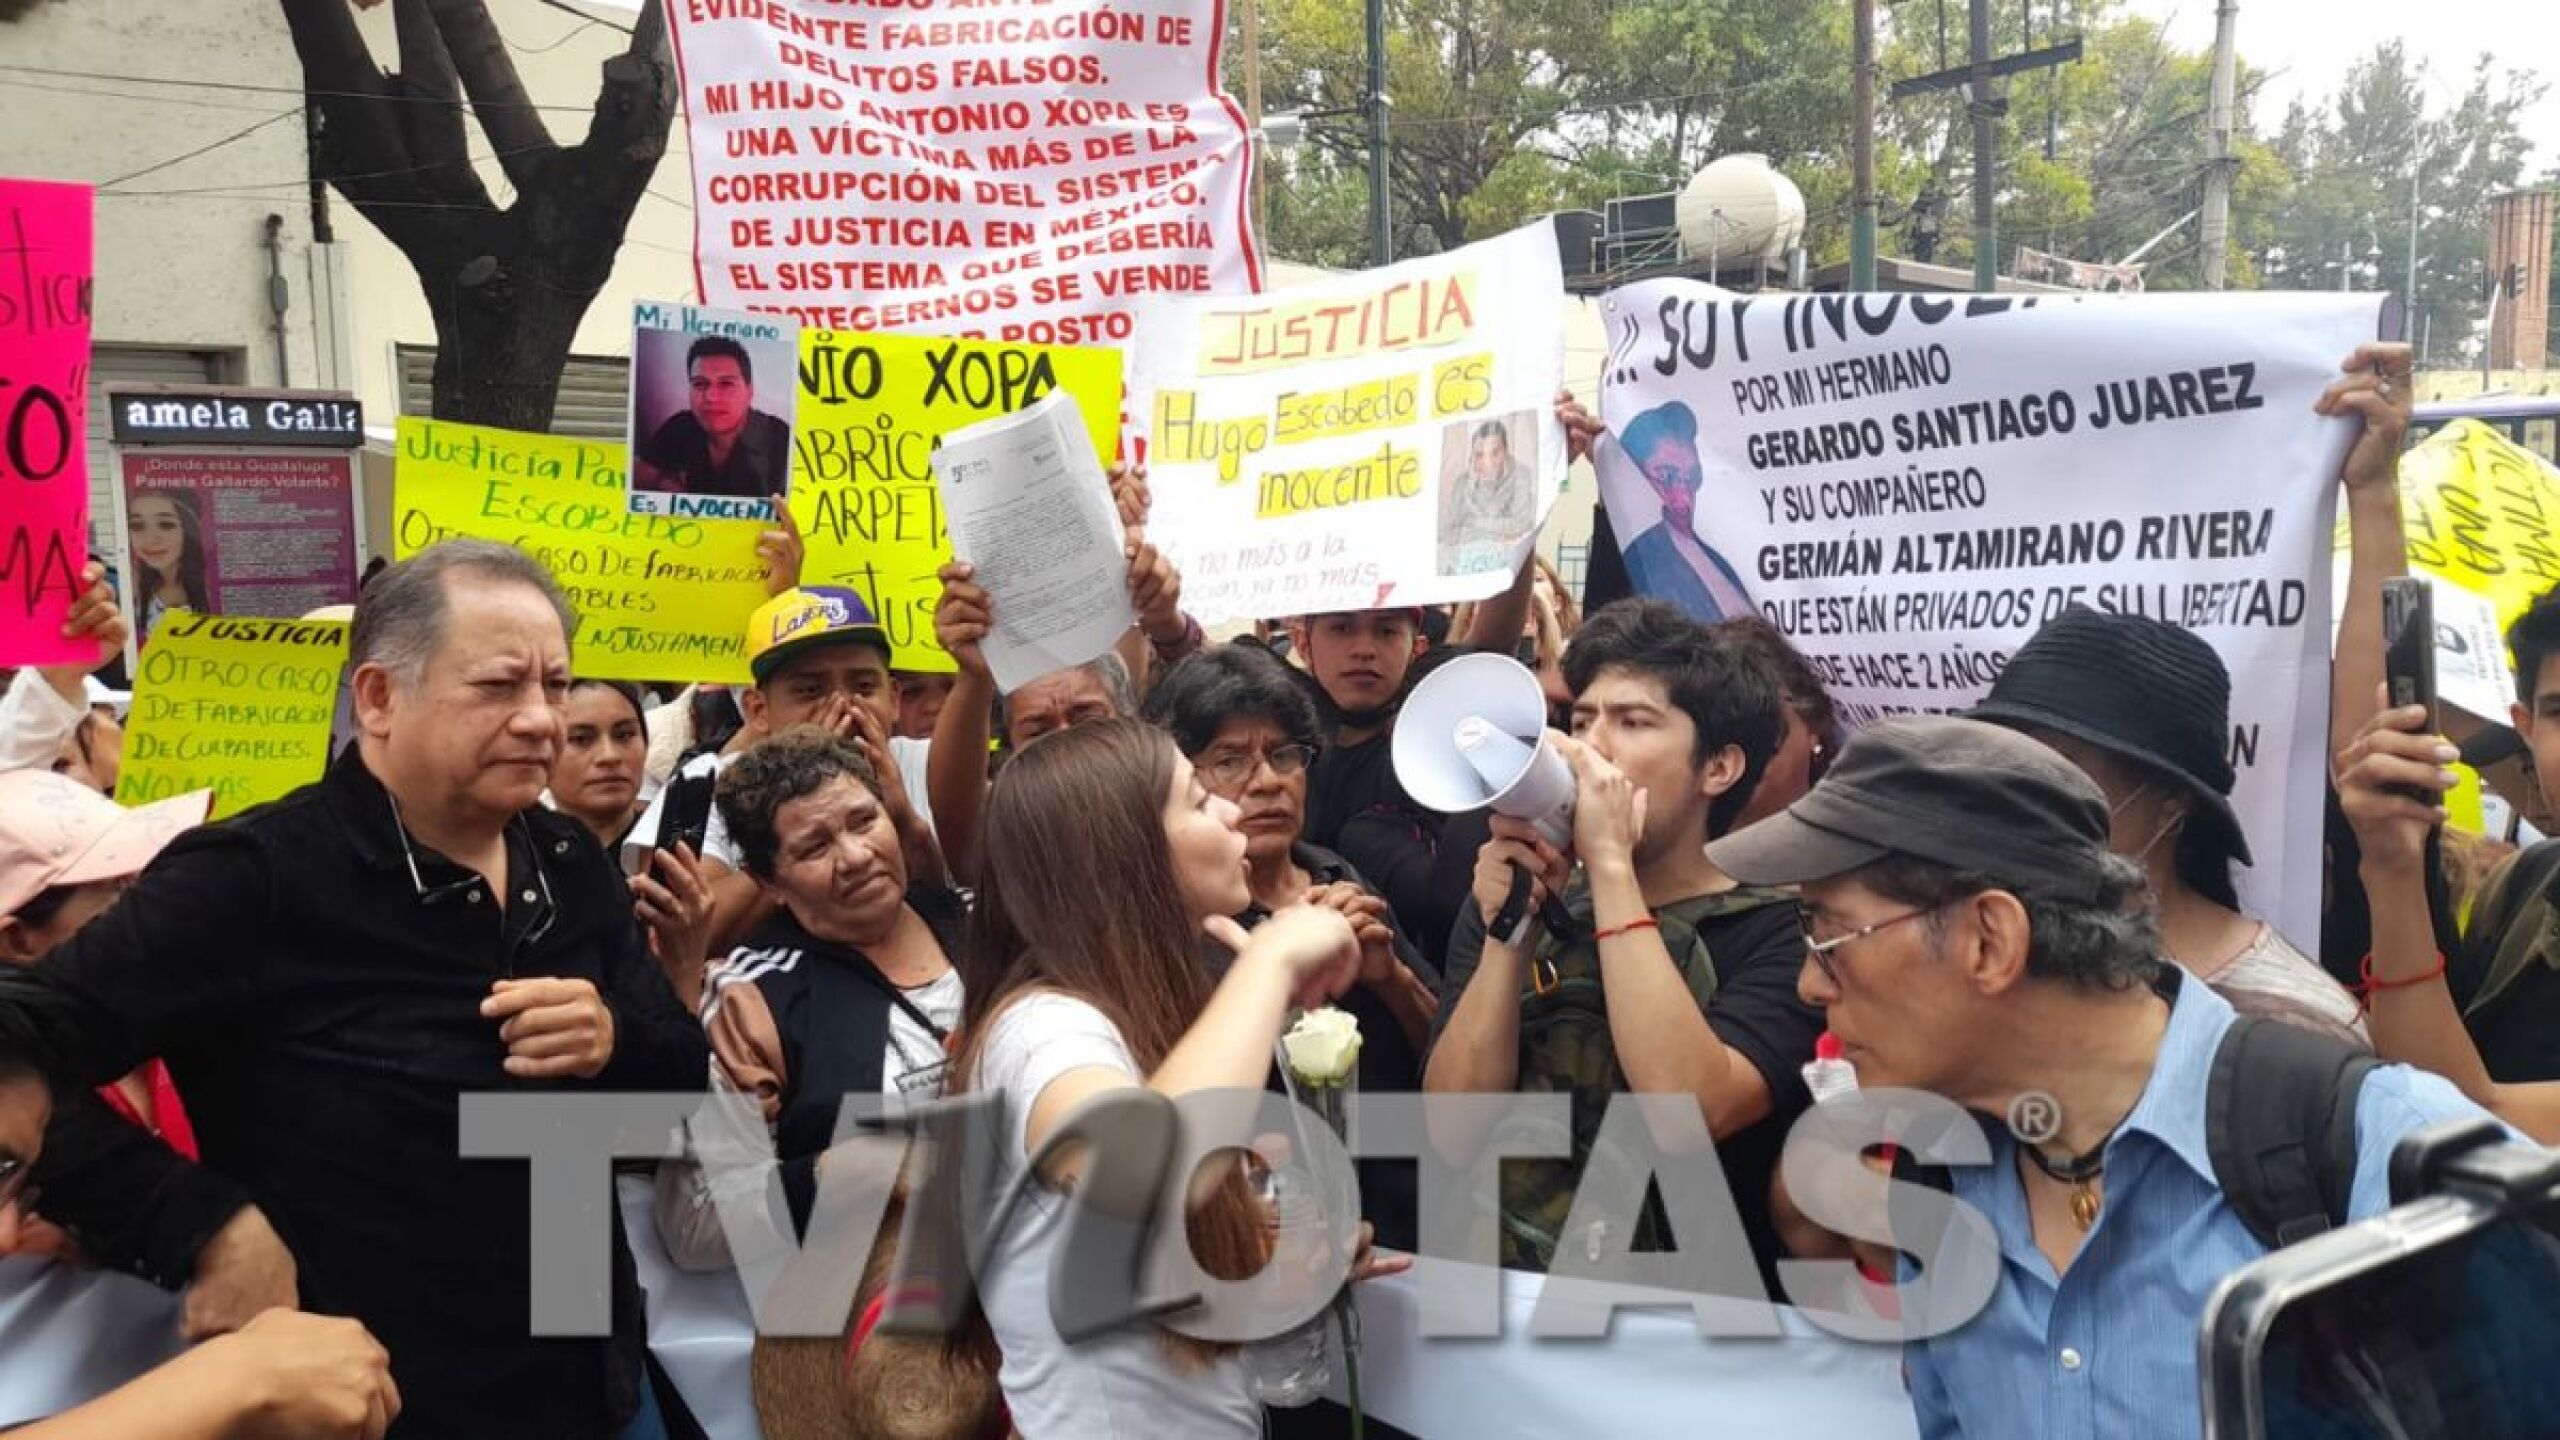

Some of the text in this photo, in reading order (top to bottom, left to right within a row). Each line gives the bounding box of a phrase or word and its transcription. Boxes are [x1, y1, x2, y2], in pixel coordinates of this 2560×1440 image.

[690, 0, 1192, 49] EVIDENTE FABRICACIÓN DE
[779, 40, 1108, 93] DELITOS FALSOS.
[705, 81, 1189, 135] MI HIJO ANTONIO XOPA ES
[727, 120, 1198, 171] UNA VÍCTIMA MÁS DE LA
[710, 168, 961, 203] CORRUPCIÓN
[974, 181, 1045, 207] DEL
[732, 181, 1208, 248] DE JUSTICIA EN MÉXICO.
[729, 215, 1213, 290] EL SISTEMA QUE DEBERÍA
[1030, 274, 1082, 304] SE
[1093, 265, 1211, 297] VENDE
[682, 307, 780, 340] Hermano
[1210, 275, 1476, 364] JUSTICIA
[922, 342, 1058, 413] XOPA
[1732, 342, 1951, 416] POR MI HERMANO
[127, 399, 250, 428] amela
[1163, 391, 1268, 482] Hugo
[1275, 379, 1416, 438] Escobedo
[1748, 362, 2264, 469] GERARDO SANTIAGO JUAREZ
[406, 424, 561, 479] Justicia
[1257, 440, 1423, 514] inocente
[481, 479, 702, 548] ESCOBEDO
[1760, 465, 1987, 524] Y SU COMPAÑERO
[598, 544, 640, 576] DE
[1758, 529, 1883, 581] GERMÁN
[1892, 519, 2125, 573] ALTAMIRANO
[2136, 508, 2274, 560] RIVERA
[168, 616, 343, 646] JUSTICIA
[1763, 598, 1813, 635] QUE
[1815, 584, 1887, 634] ESTÁN
[1894, 588, 2034, 632] PRIVADOS
[2158, 579, 2306, 628] LIBERTAD
[145, 650, 332, 695] OTRO CASO
[1850, 653, 1920, 689] HACE
[1918, 653, 1938, 689] 2
[144, 694, 187, 721] DE
[121, 768, 173, 801] NO
